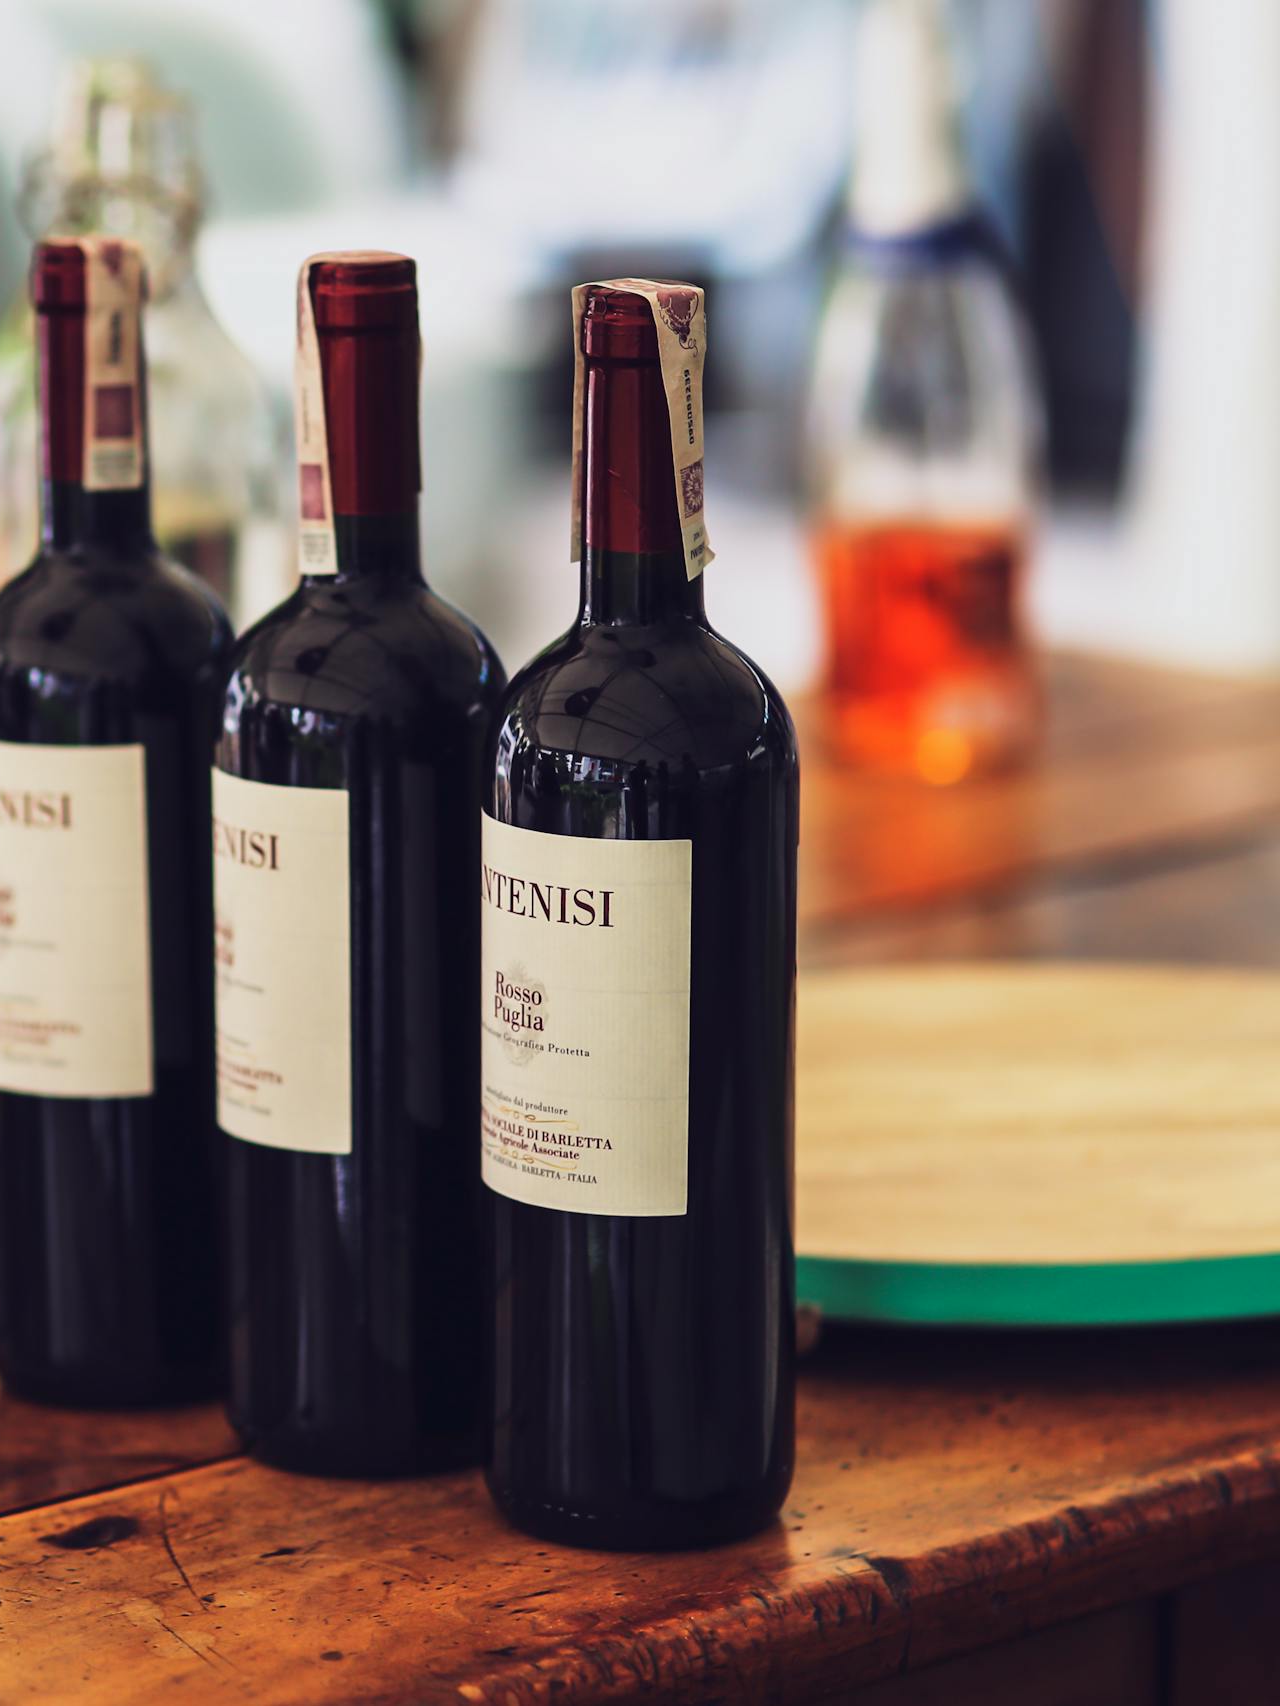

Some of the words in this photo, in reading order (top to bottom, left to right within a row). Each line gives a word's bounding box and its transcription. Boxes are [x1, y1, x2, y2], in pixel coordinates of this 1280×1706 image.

[496, 970, 542, 1005] Rosso
[494, 995, 544, 1032] Puglia
[548, 1042, 590, 1057] Protetta
[513, 1096, 523, 1106] dal
[525, 1102, 568, 1116] produttore
[527, 1128, 538, 1140] DI
[542, 1131, 613, 1150] BARLETTA
[531, 1143, 580, 1160] Associate
[521, 1163, 560, 1179] BARLETTA
[567, 1172, 597, 1184] ITALIA
